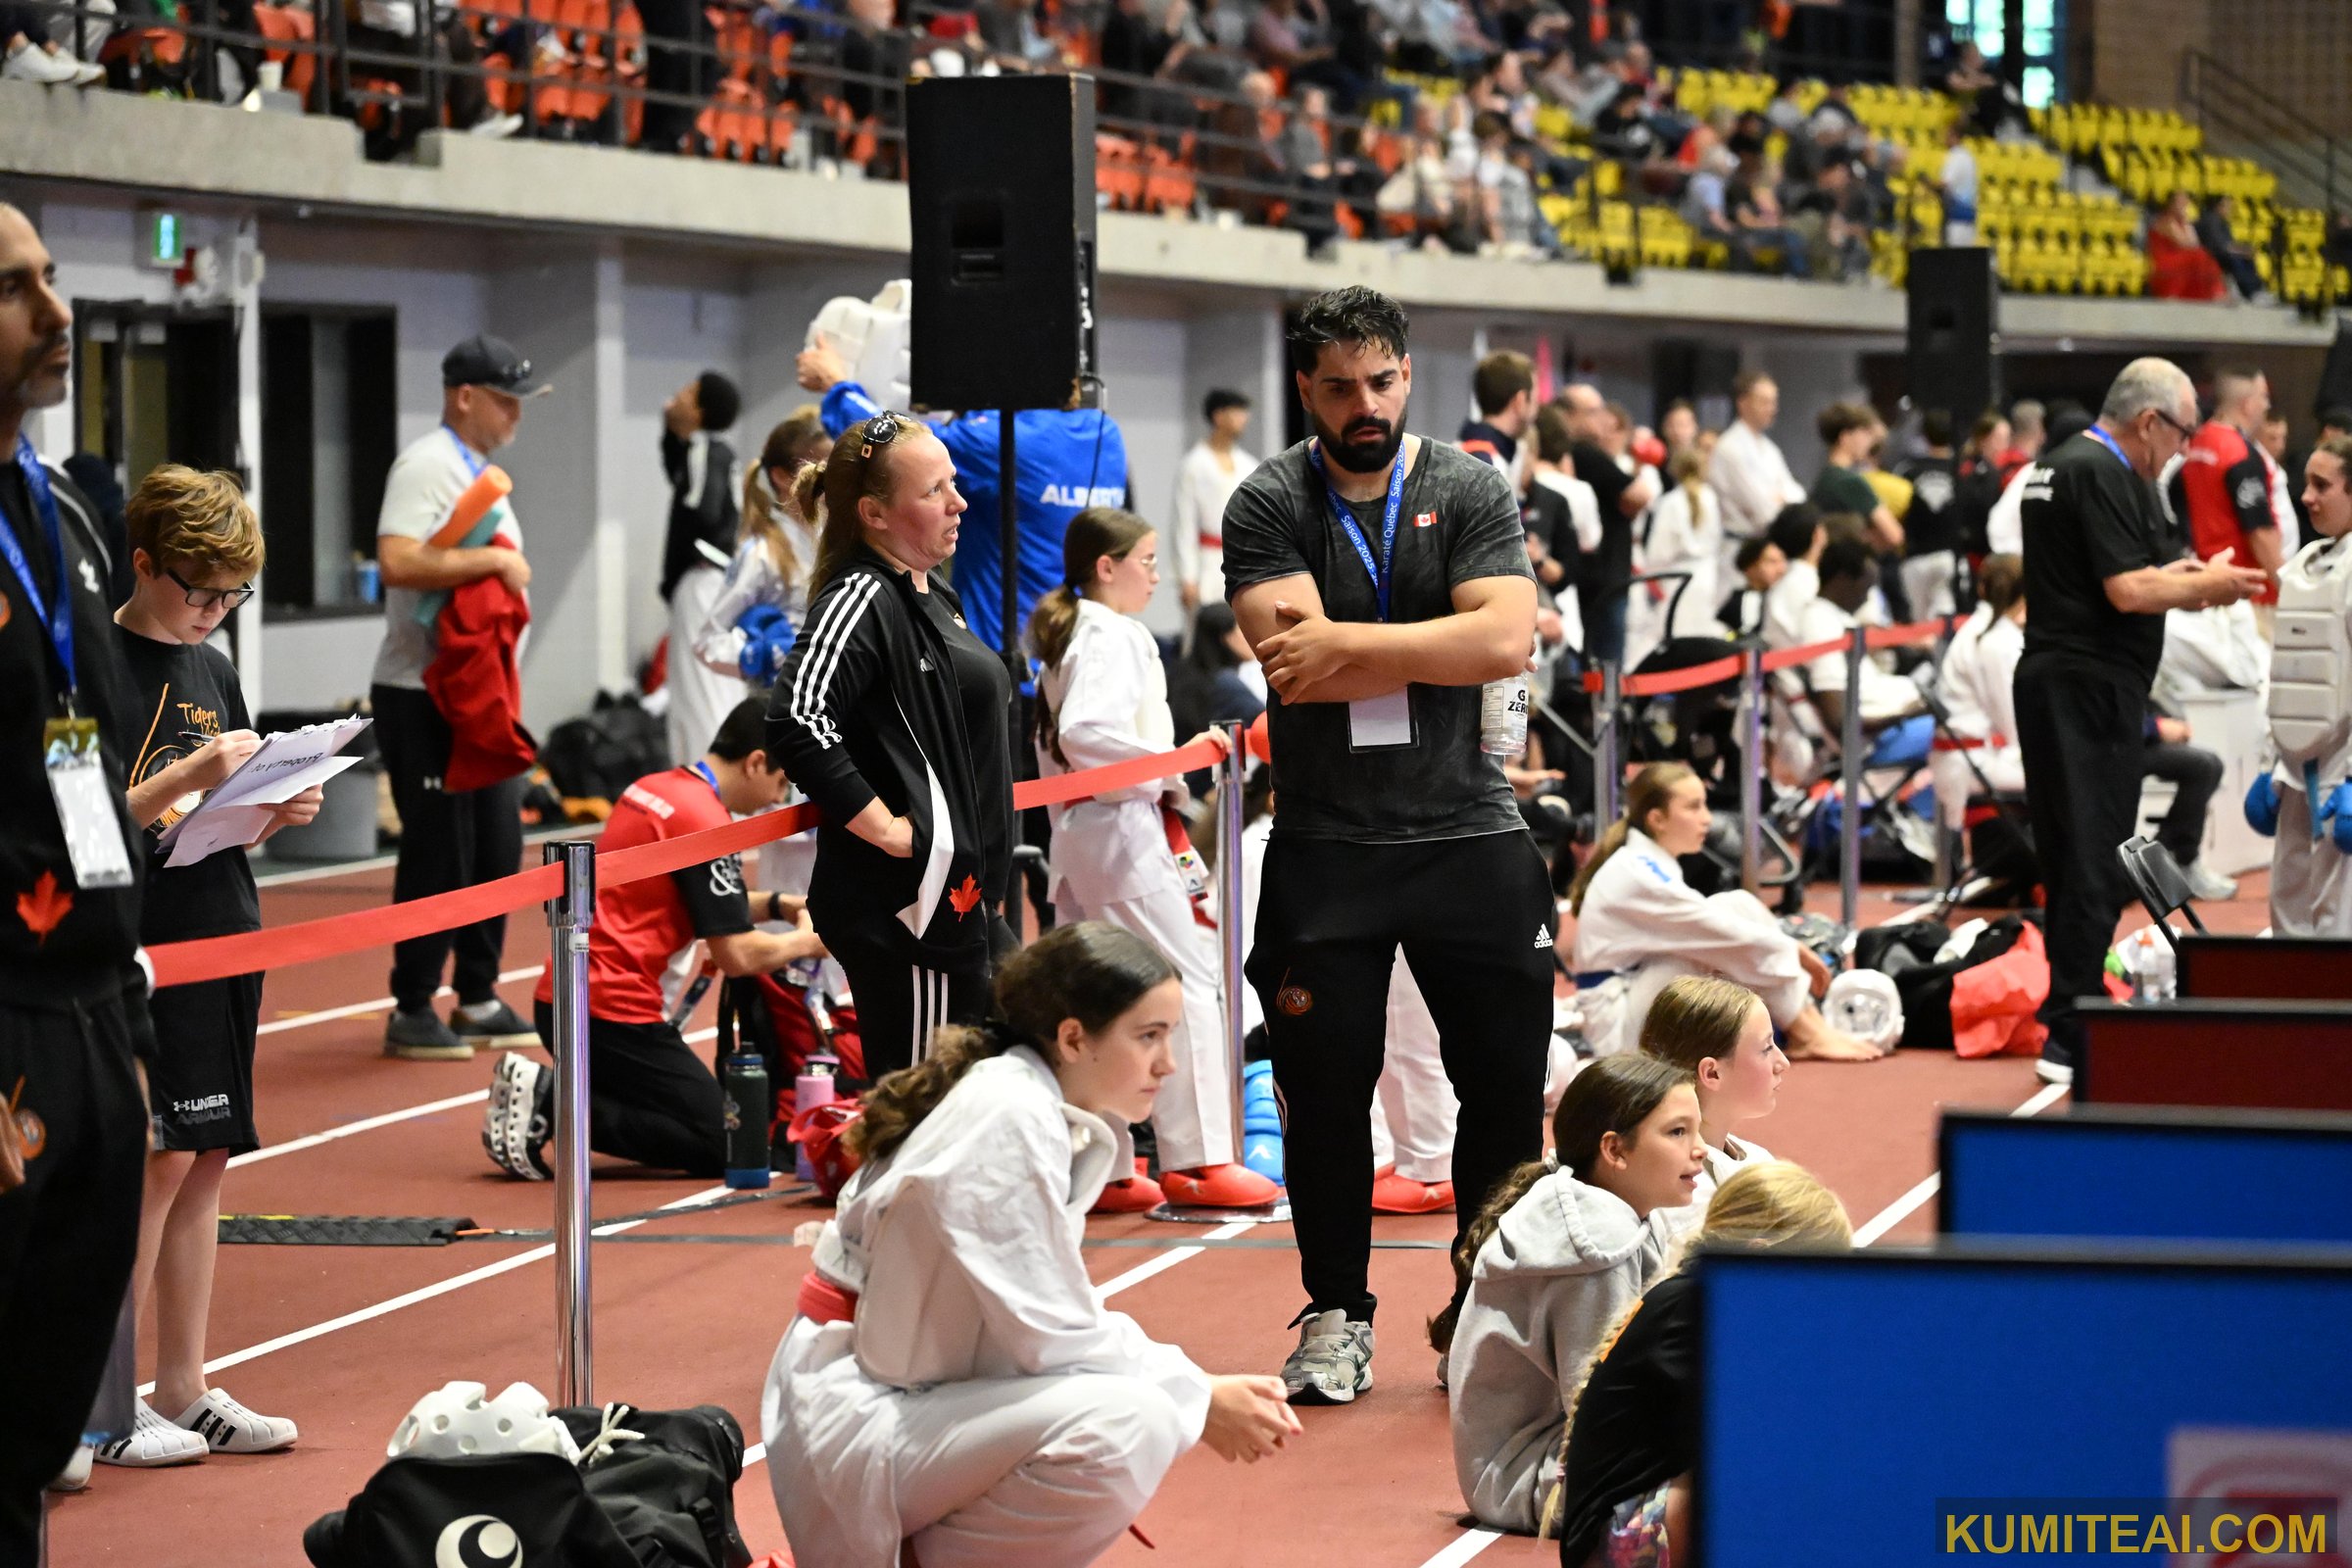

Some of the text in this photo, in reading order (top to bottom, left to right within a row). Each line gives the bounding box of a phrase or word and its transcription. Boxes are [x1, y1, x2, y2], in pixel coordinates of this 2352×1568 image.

[1391, 469, 1402, 497] Saison
[1341, 514, 1361, 545] Saison
[1384, 502, 1398, 538] Québec
[1382, 539, 1392, 573] Karaté
[1507, 701, 1529, 714] ZER
[1517, 689, 1526, 702] G
[1535, 938, 1553, 949] adidas
